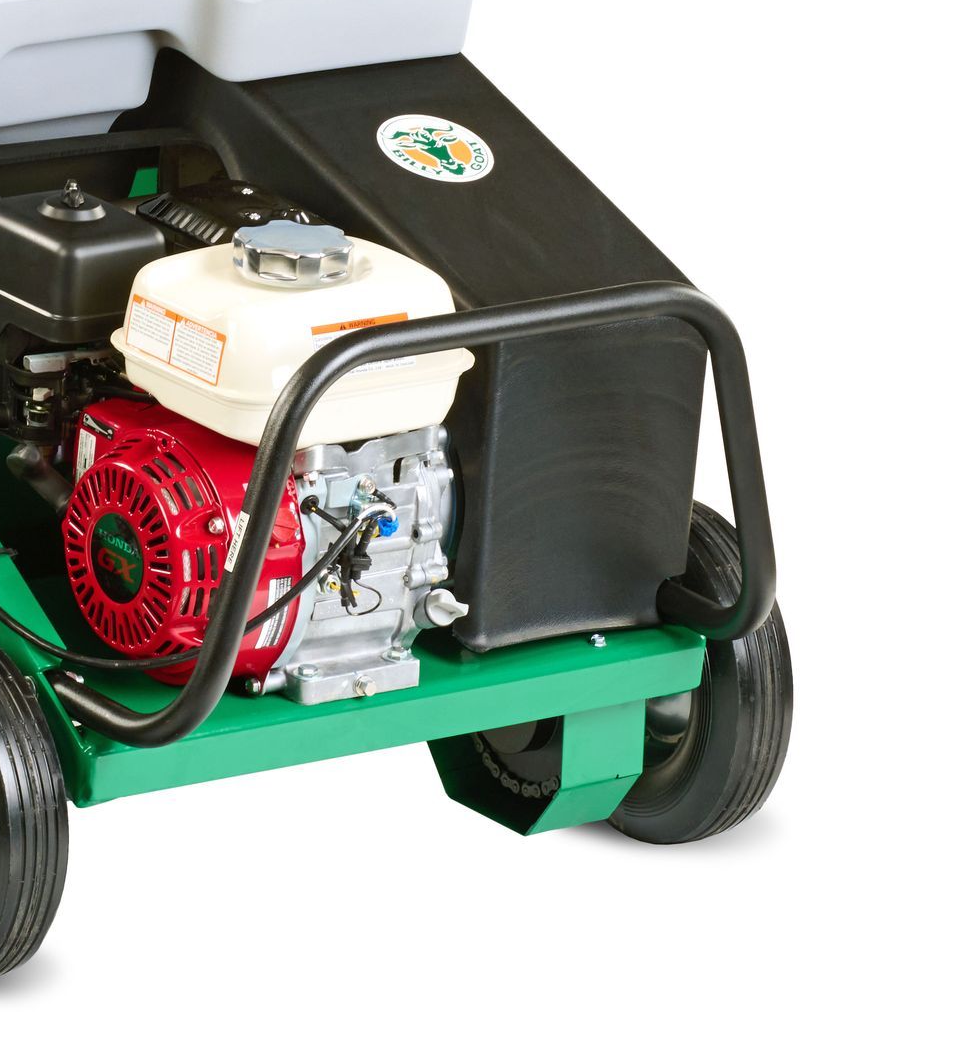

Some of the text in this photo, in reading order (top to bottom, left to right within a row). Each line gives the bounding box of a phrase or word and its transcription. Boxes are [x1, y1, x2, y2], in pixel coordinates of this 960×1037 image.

[392, 140, 485, 175] BILLY GOAT
[228, 518, 245, 564] LIFT HERE
[97, 547, 137, 584] GX
